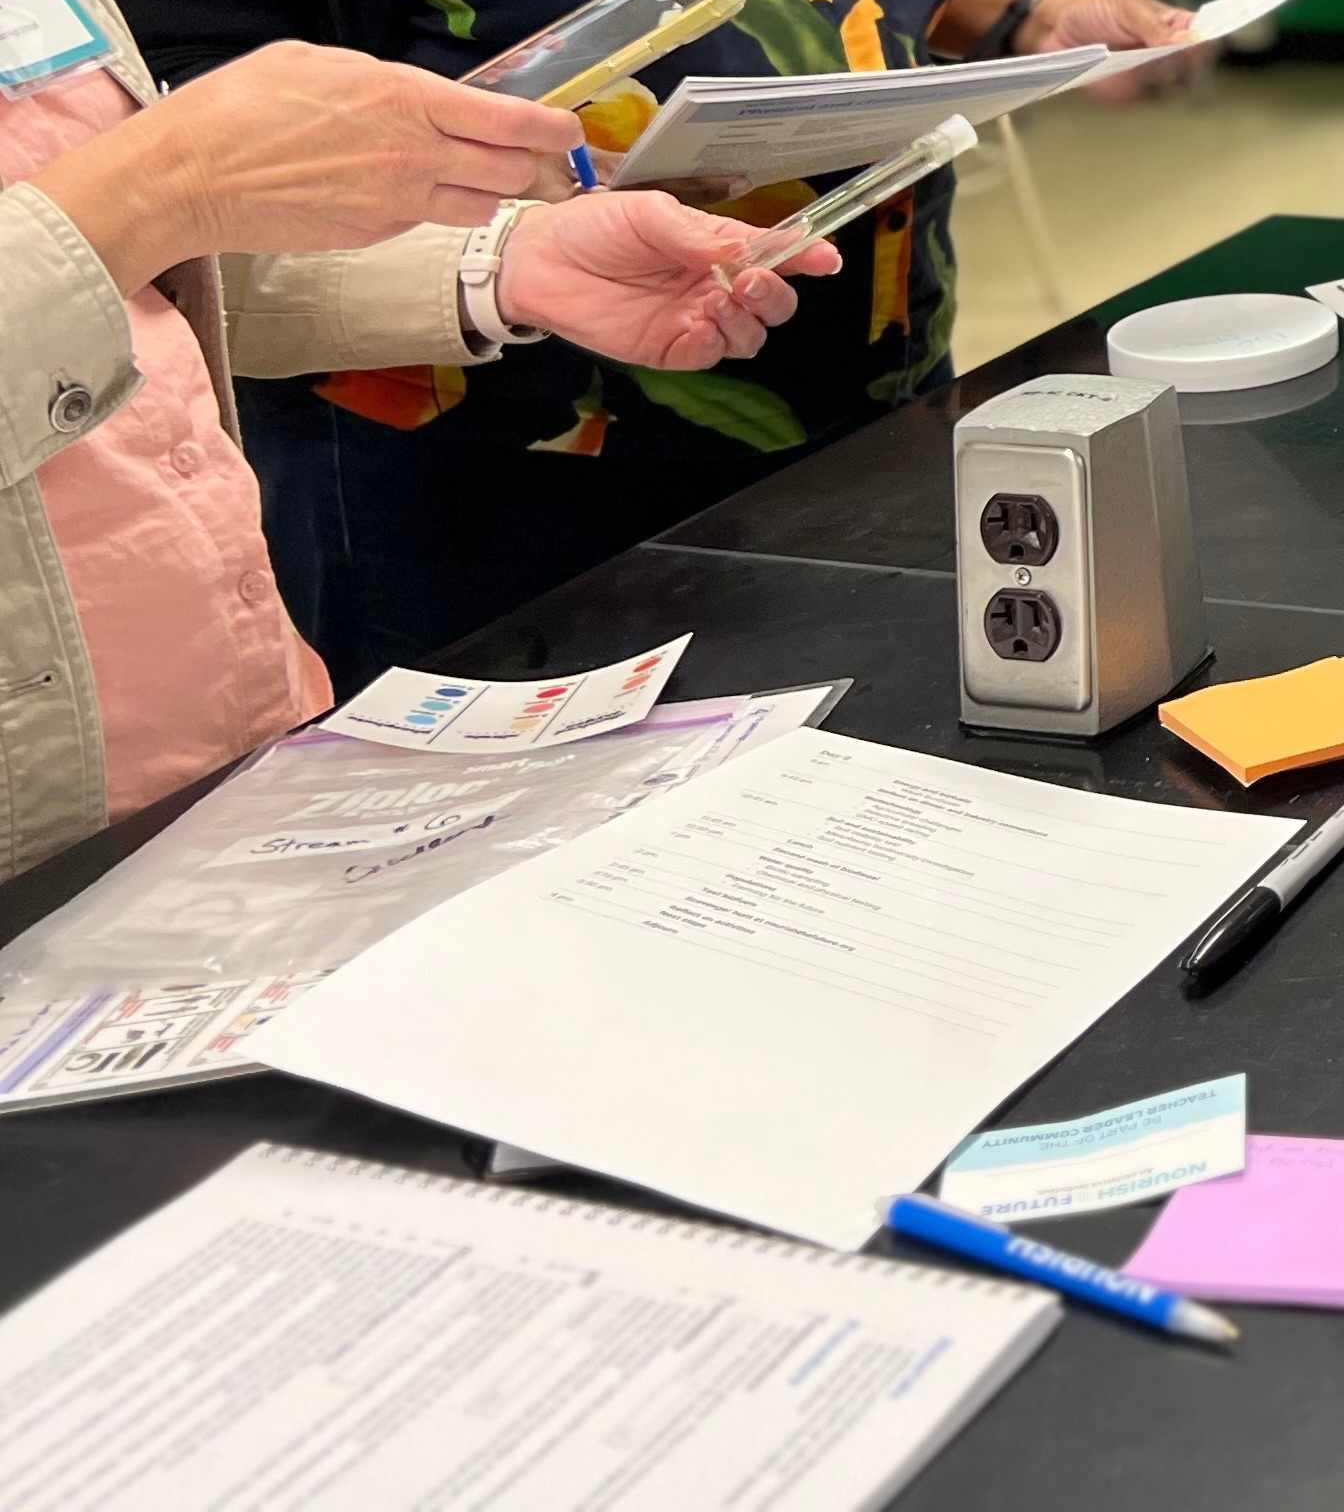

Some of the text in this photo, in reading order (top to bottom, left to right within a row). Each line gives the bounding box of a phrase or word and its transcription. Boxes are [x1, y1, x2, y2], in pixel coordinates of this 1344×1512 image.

[250, 836, 371, 855] Stream
[981, 1088, 1217, 1149] TEACHER LEADER COMMUNITY
[1096, 1161, 1207, 1200] NOURISH
[979, 1194, 1072, 1217] FUTURE
